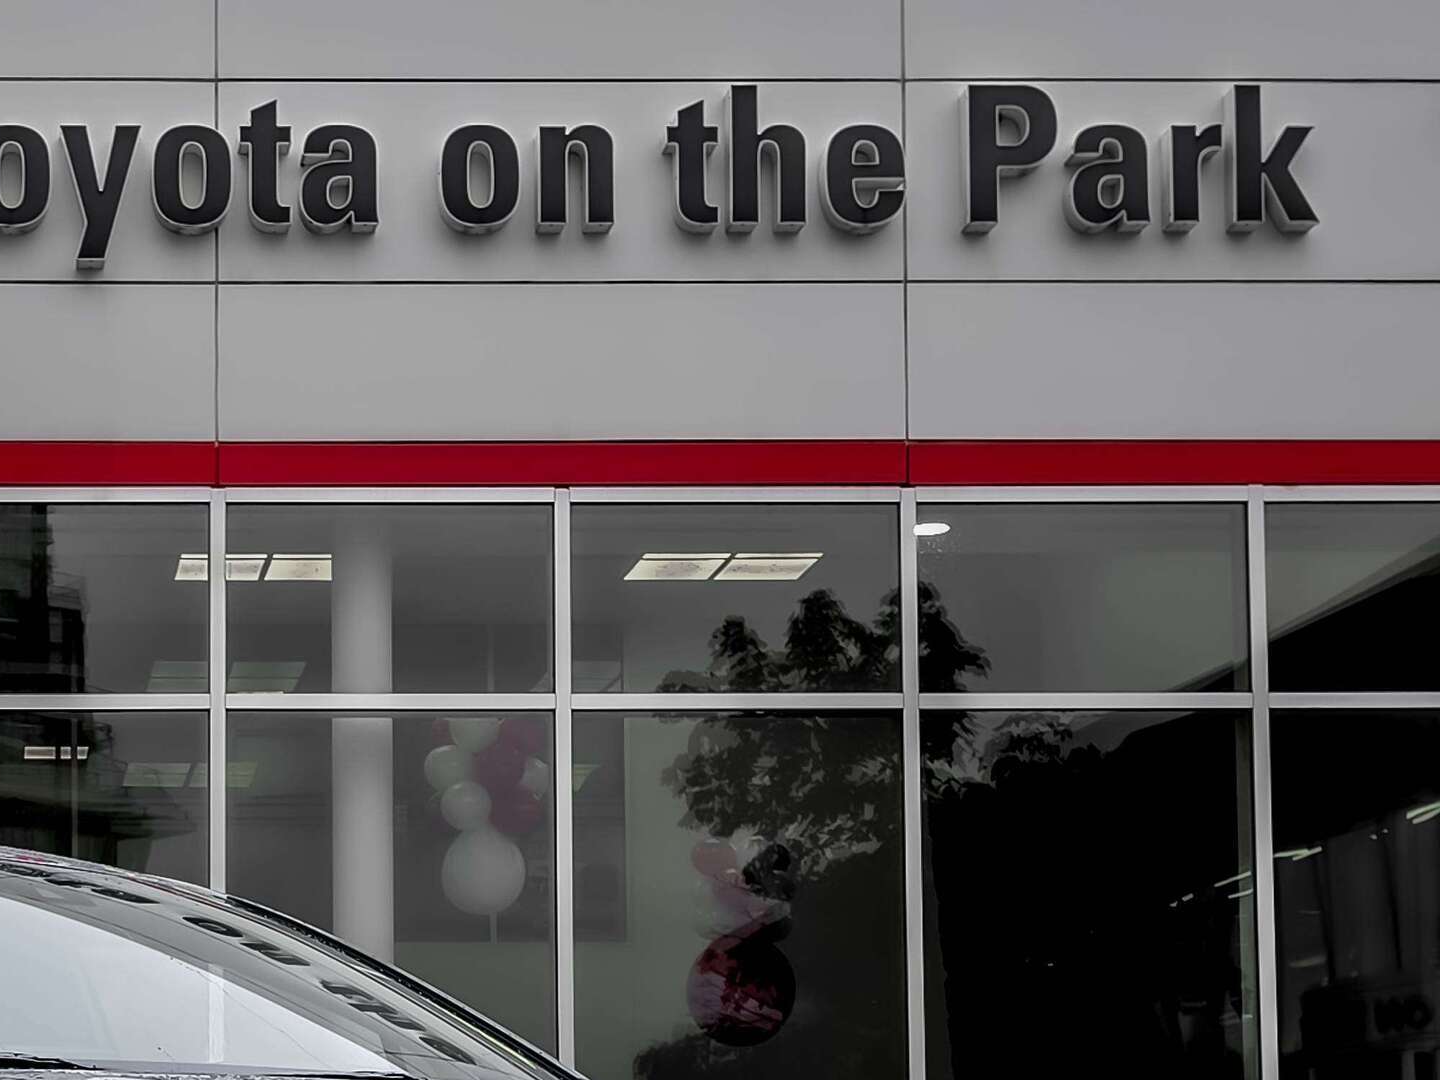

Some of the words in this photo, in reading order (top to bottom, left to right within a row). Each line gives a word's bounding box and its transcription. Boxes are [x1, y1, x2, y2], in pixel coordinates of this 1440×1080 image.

[439, 123, 615, 233] on
[663, 84, 906, 233] the
[960, 84, 1320, 233] Park
